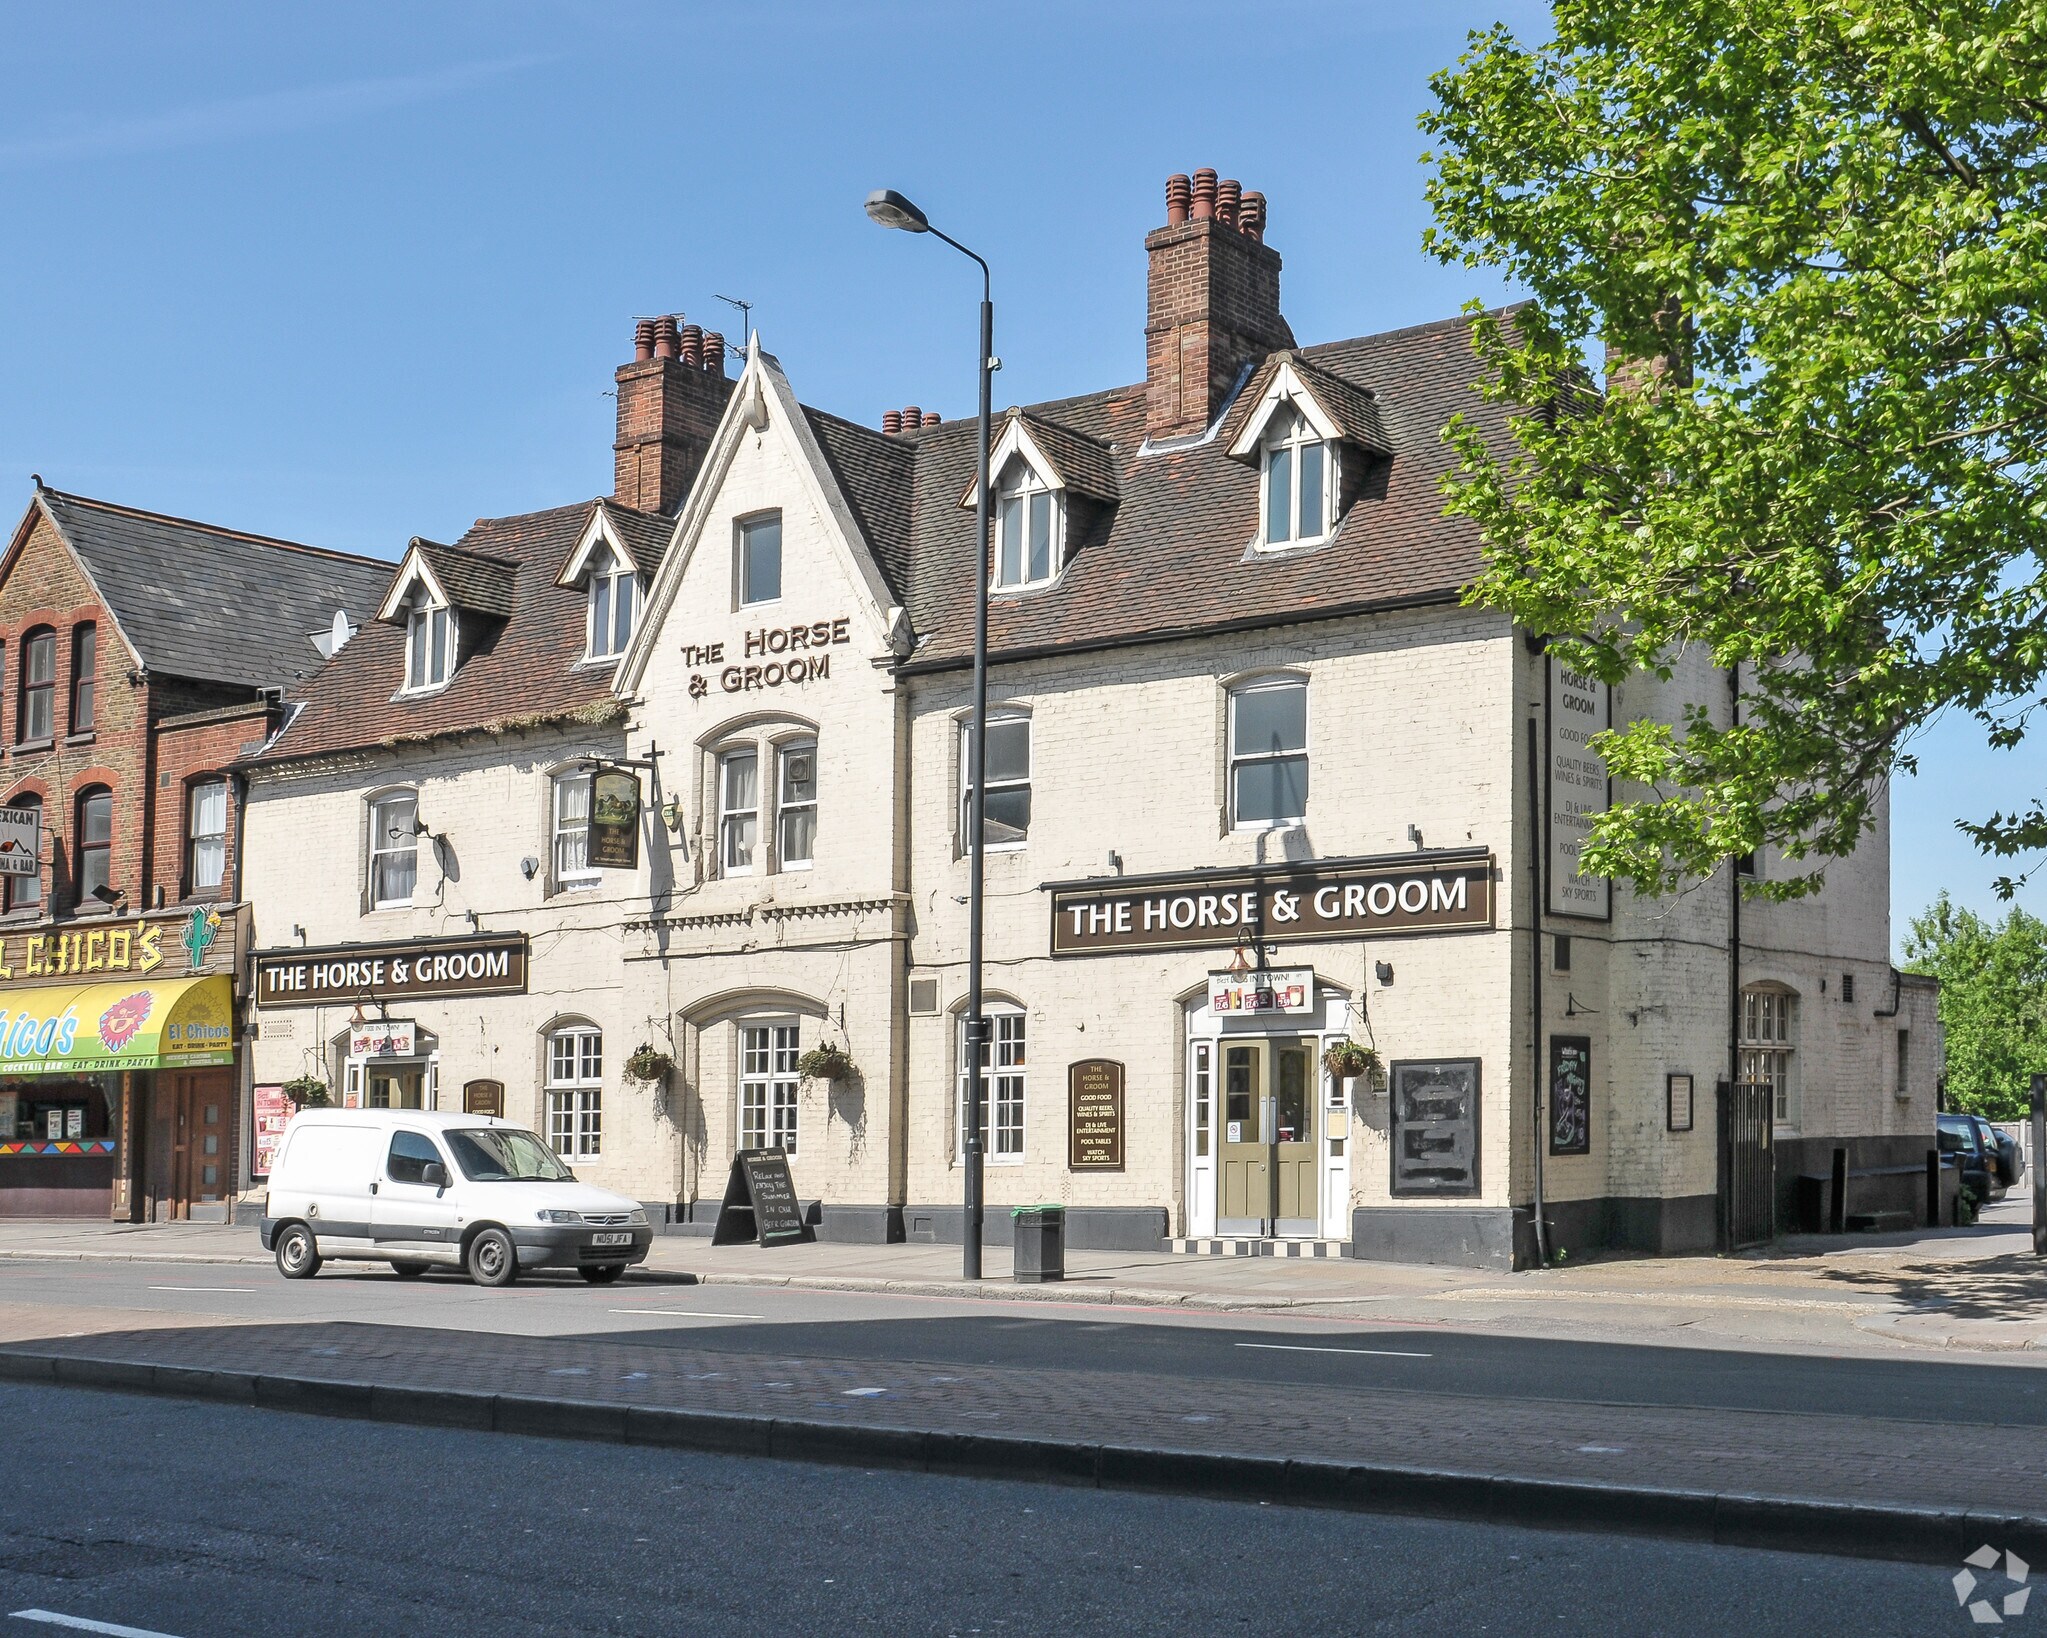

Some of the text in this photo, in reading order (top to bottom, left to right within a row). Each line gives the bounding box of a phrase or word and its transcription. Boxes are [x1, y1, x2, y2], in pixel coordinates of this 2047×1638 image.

[681, 616, 850, 668] THE HORSE
[688, 654, 830, 699] & GROOM
[1560, 669, 1596, 694] HORSE &
[1562, 694, 1595, 716] GROOM
[1560, 727, 1579, 742] GOOD
[1556, 755, 1582, 772] QUALITY
[1554, 770, 1602, 791] WINES & SPIRITS
[1566, 800, 1572, 814] DJ
[1574, 802, 1579, 814] &
[0, 811, 34, 826] XICAN
[602, 846, 625, 854] GROOM
[1560, 842, 1576, 856] POOL
[20, 859, 34, 872] BAR
[1568, 873, 1590, 886] WATCH
[1562, 887, 1596, 902] SKY SPORTS
[1068, 876, 1467, 935] THE HORSE & GROOM
[26, 920, 164, 976] CHICO'S
[266, 950, 509, 992] THE HORSE & GROOM
[1250, 974, 1258, 982] IN
[168, 1022, 230, 1040] El Chico's
[2, 1058, 154, 1072] COCKTAIL BAR EAT DRINK PARTY
